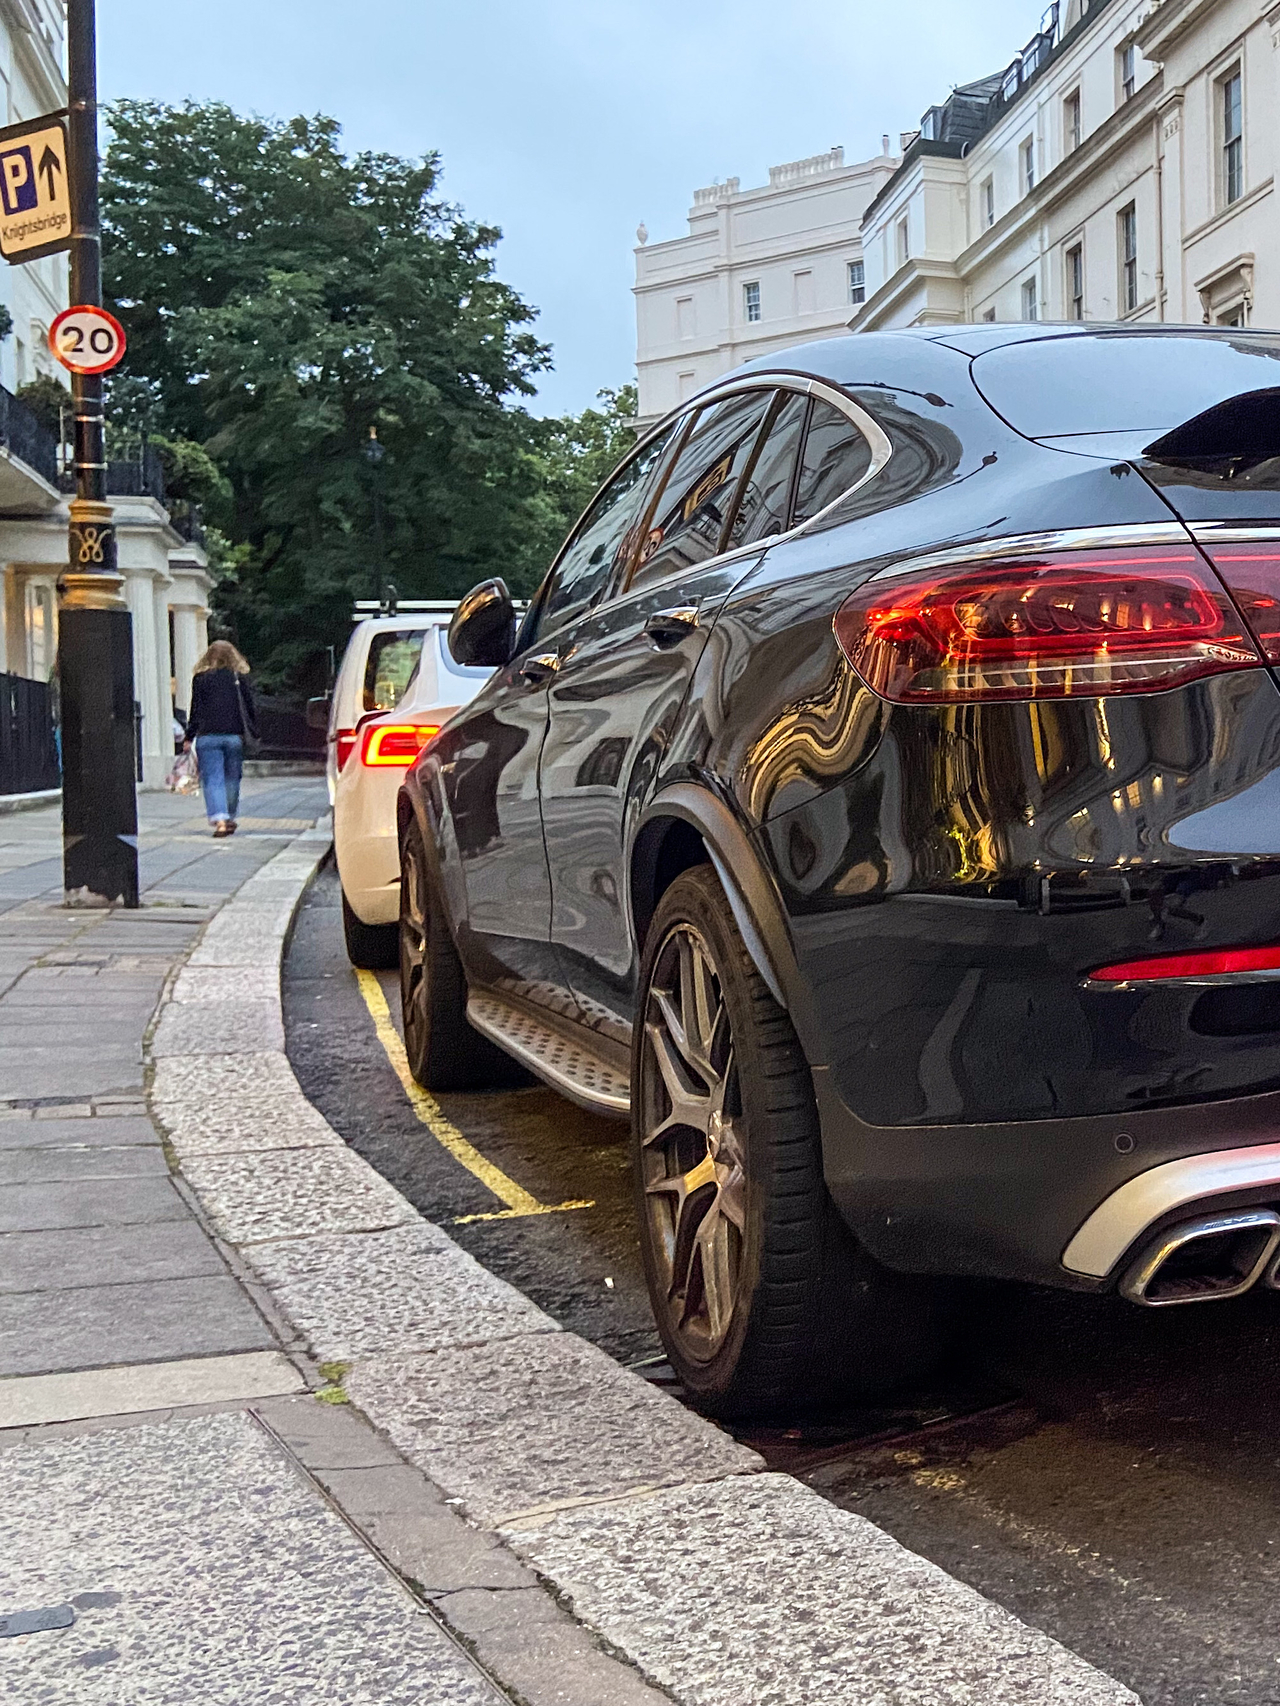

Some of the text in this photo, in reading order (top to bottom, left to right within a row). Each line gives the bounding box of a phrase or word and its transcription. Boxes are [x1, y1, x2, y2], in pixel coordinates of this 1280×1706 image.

[2, 154, 28, 208] P
[2, 213, 67, 240] Knightsbridge
[62, 326, 114, 354] 20
